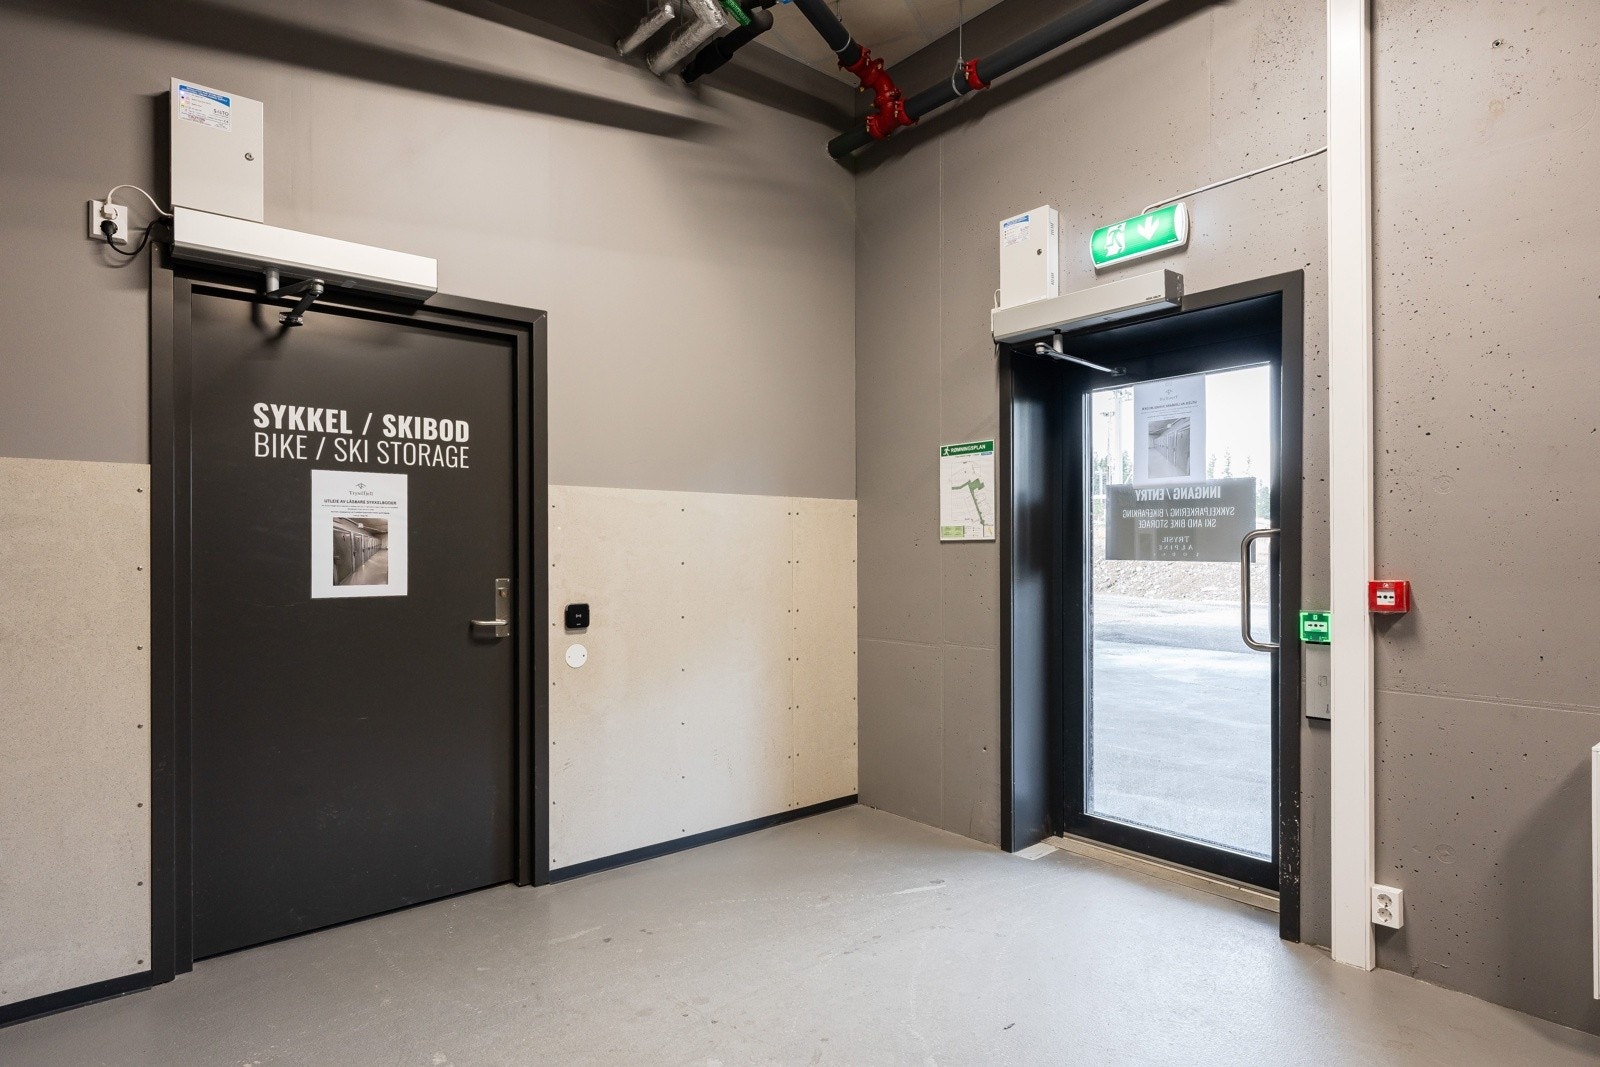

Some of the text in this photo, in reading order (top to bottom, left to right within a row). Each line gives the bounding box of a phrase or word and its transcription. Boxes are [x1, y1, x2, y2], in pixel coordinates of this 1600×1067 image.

[253, 402, 470, 443] SYKKEL / SKIBOD
[254, 432, 470, 469] BIKE / SKI STORAGE
